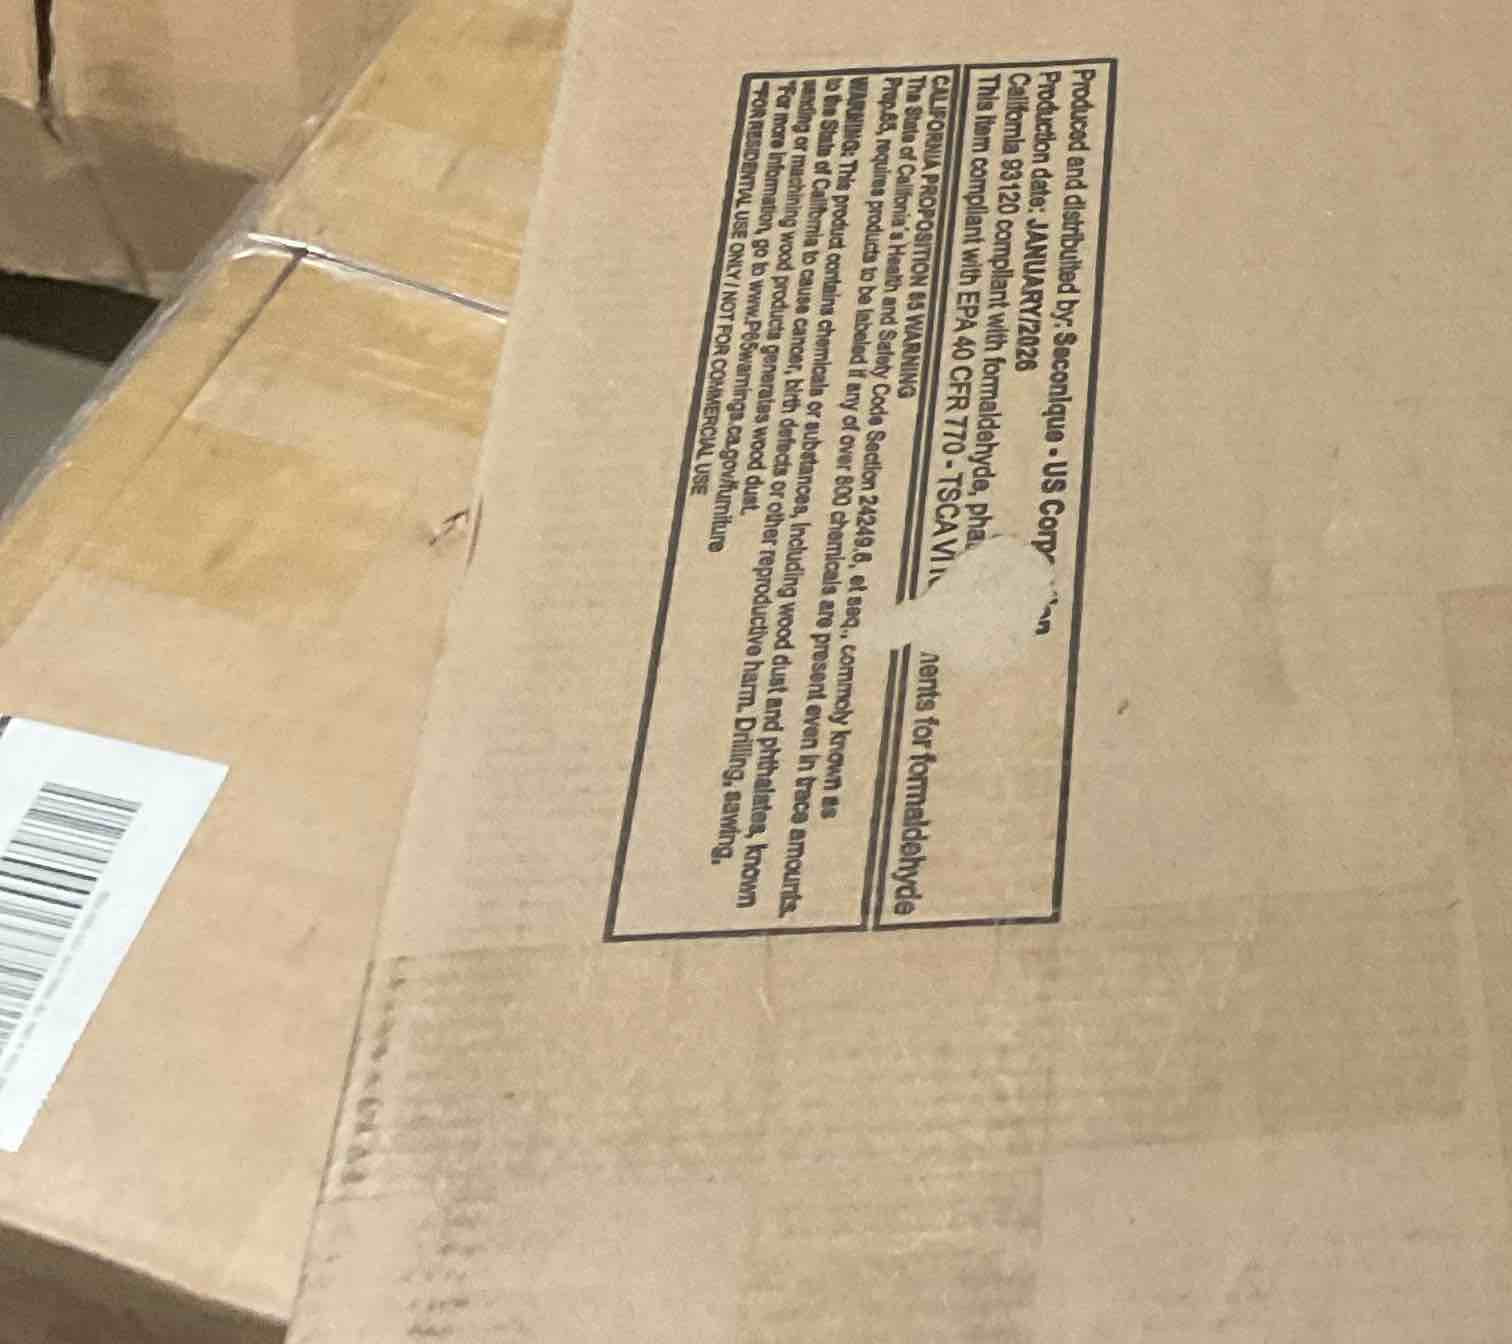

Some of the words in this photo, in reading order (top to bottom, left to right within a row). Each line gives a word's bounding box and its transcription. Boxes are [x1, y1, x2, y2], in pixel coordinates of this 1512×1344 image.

[975, 72, 1002, 111] This
[1001, 72, 1032, 155] California
[1067, 68, 1096, 152] Produced
[971, 114, 997, 153] item
[1031, 70, 1062, 164] Production
[996, 158, 1024, 215] 93120
[1027, 167, 1054, 213] date:
[1063, 155, 1088, 191] and
[961, 156, 989, 245] compliant
[957, 247, 983, 286] with
[986, 218, 1015, 309] compliant
[951, 290, 981, 332] EPA
[1014, 217, 1049, 372] JANUARY/2026
[1049, 298, 1080, 328] by:
[951, 335, 976, 360] 40
[983, 311, 1010, 352] with
[945, 365, 973, 412] CFR
[1040, 331, 1078, 442] Seconique
[941, 415, 968, 455] 770
[966, 356, 1007, 496] formaldehyde,
[1040, 460, 1068, 494] US
[930, 471, 964, 536] TSCA
[911, 715, 939, 749] for
[891, 751, 937, 915] formaldehyde
